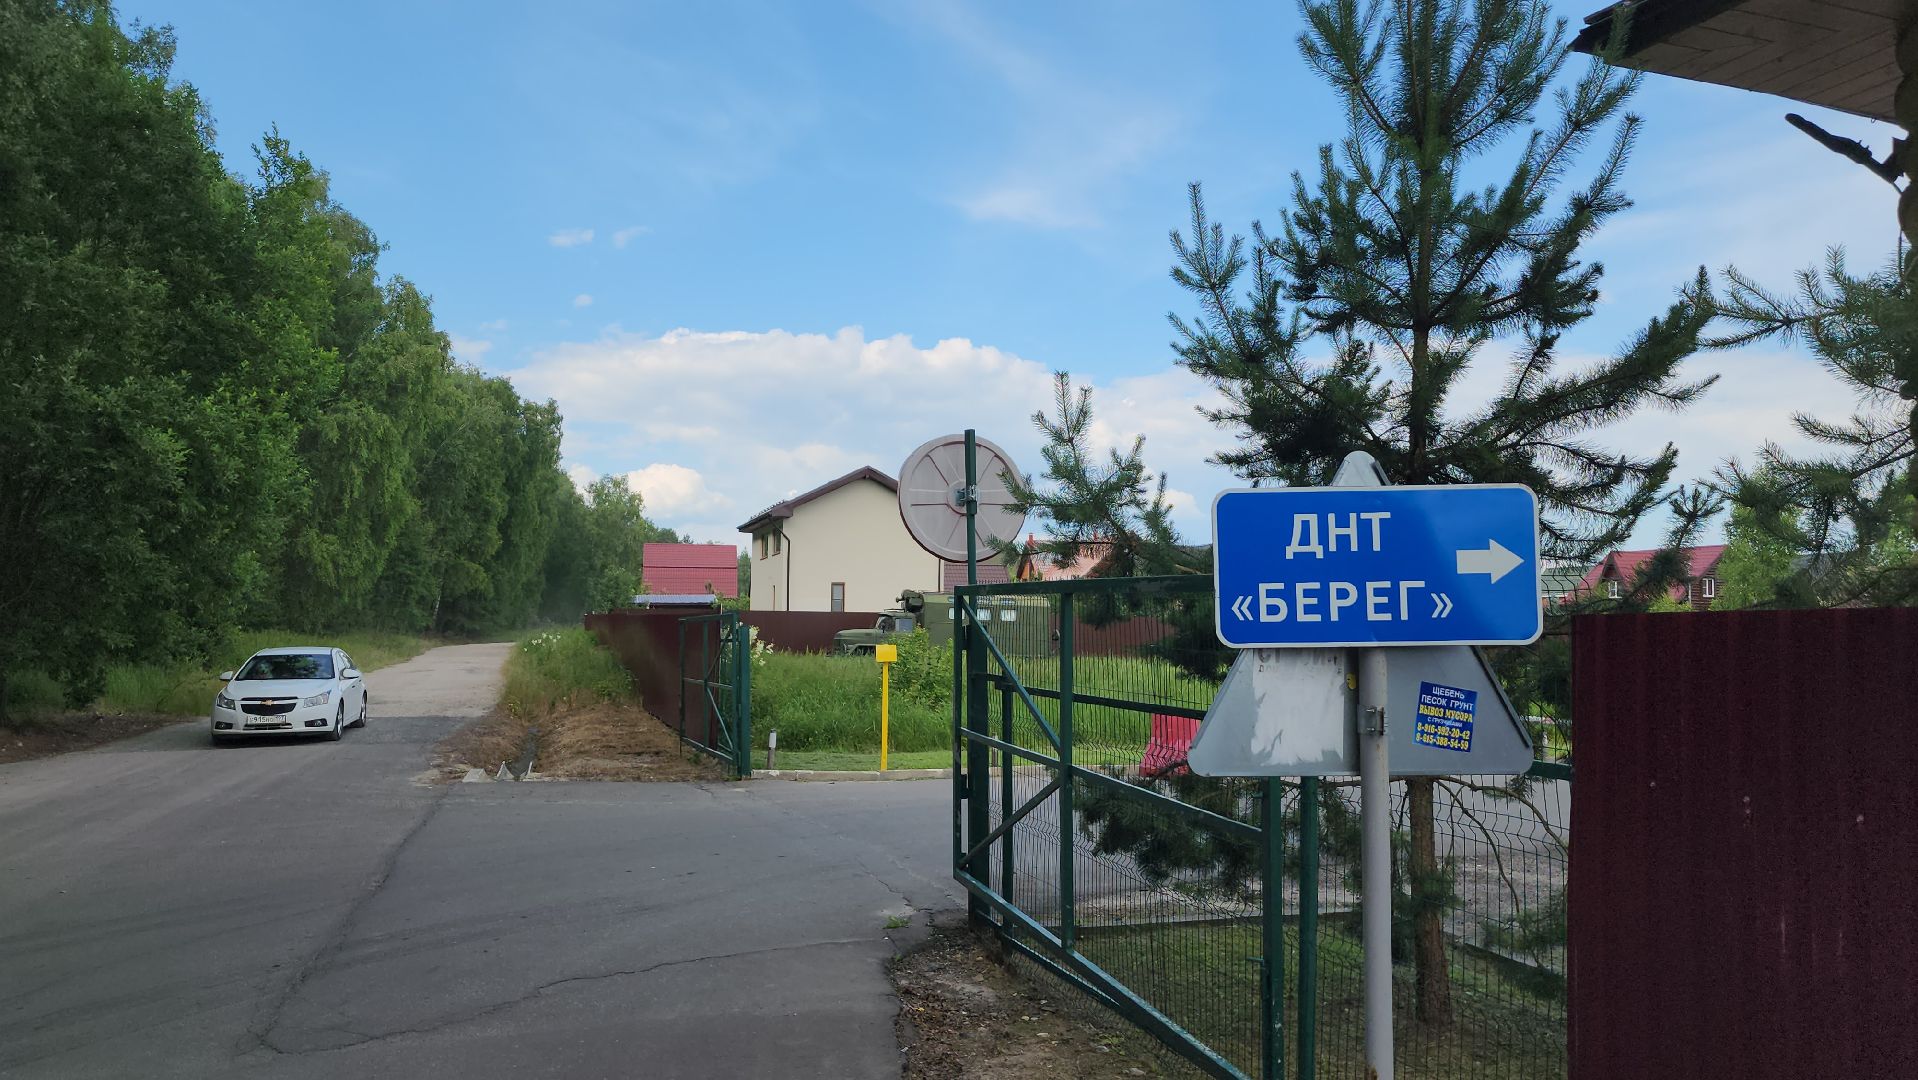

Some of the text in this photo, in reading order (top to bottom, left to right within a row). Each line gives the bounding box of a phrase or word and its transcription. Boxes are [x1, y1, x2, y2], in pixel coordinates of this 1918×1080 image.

[1285, 511, 1391, 560] ДНТ
[1231, 580, 1453, 623] «БЕРЕГ»
[1421, 694, 1474, 710] ПЕСОК ГРУНТ
[1432, 686, 1465, 699] ЩЕБЕНЬ
[1419, 704, 1473, 723] ВЫВОЗ МУСОРА
